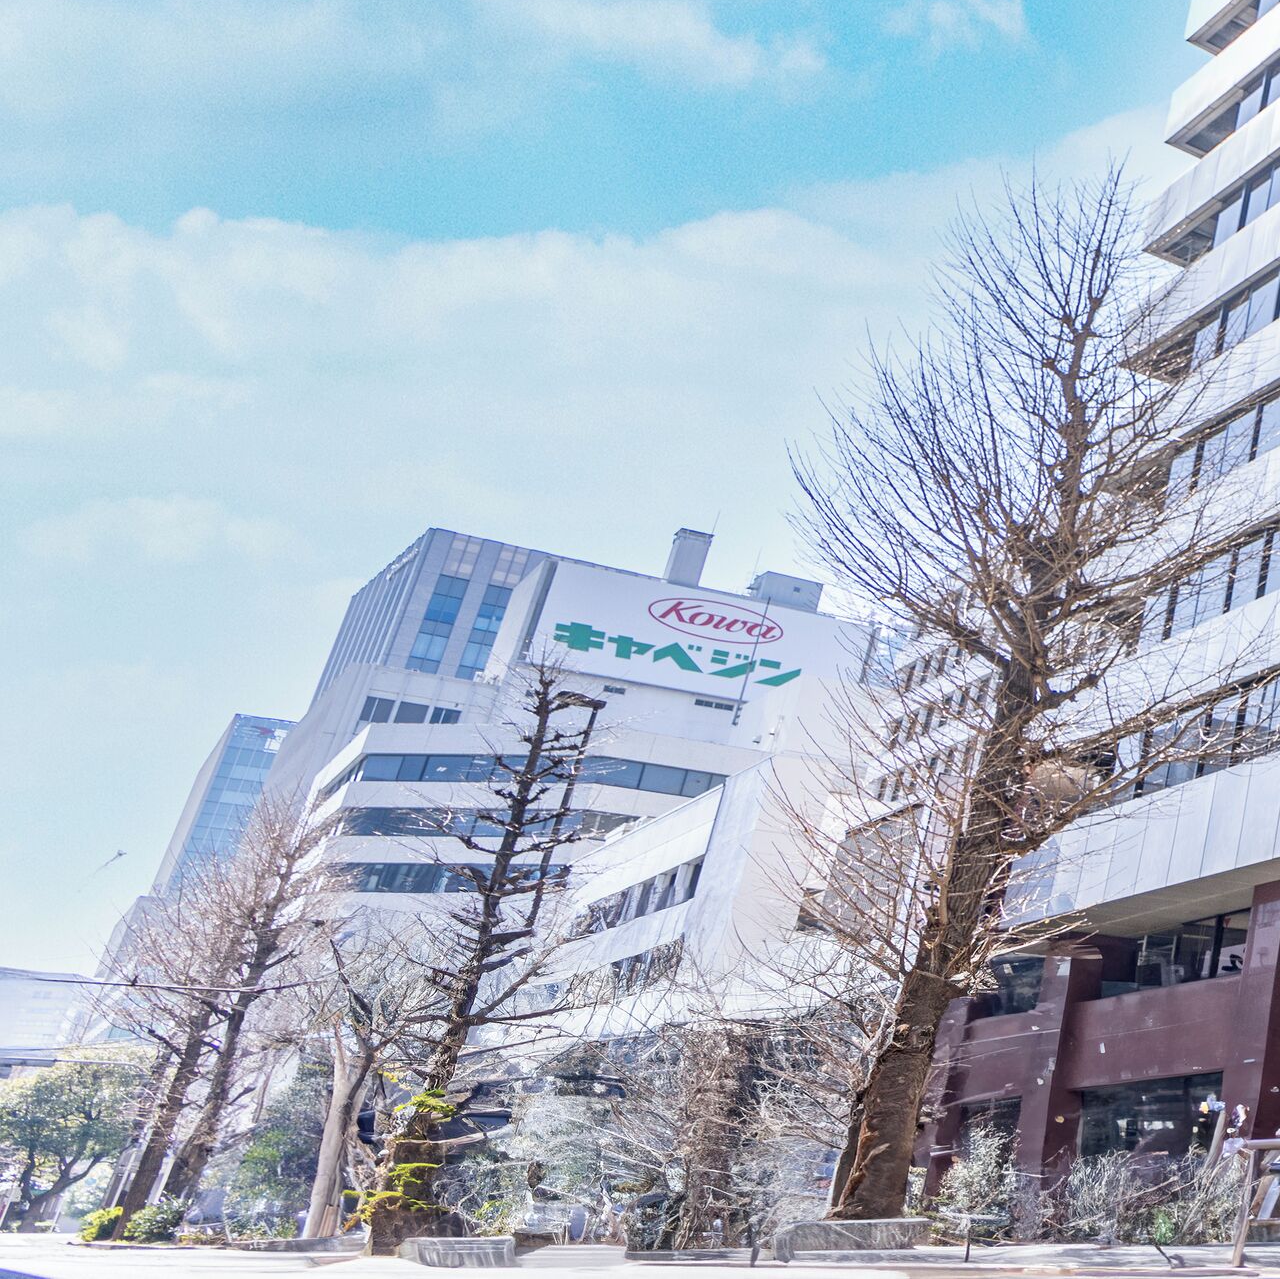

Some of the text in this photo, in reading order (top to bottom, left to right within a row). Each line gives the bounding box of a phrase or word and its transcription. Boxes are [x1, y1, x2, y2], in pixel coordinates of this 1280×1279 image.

[659, 601, 777, 640] Kowa
[553, 622, 802, 687] キャベジン
